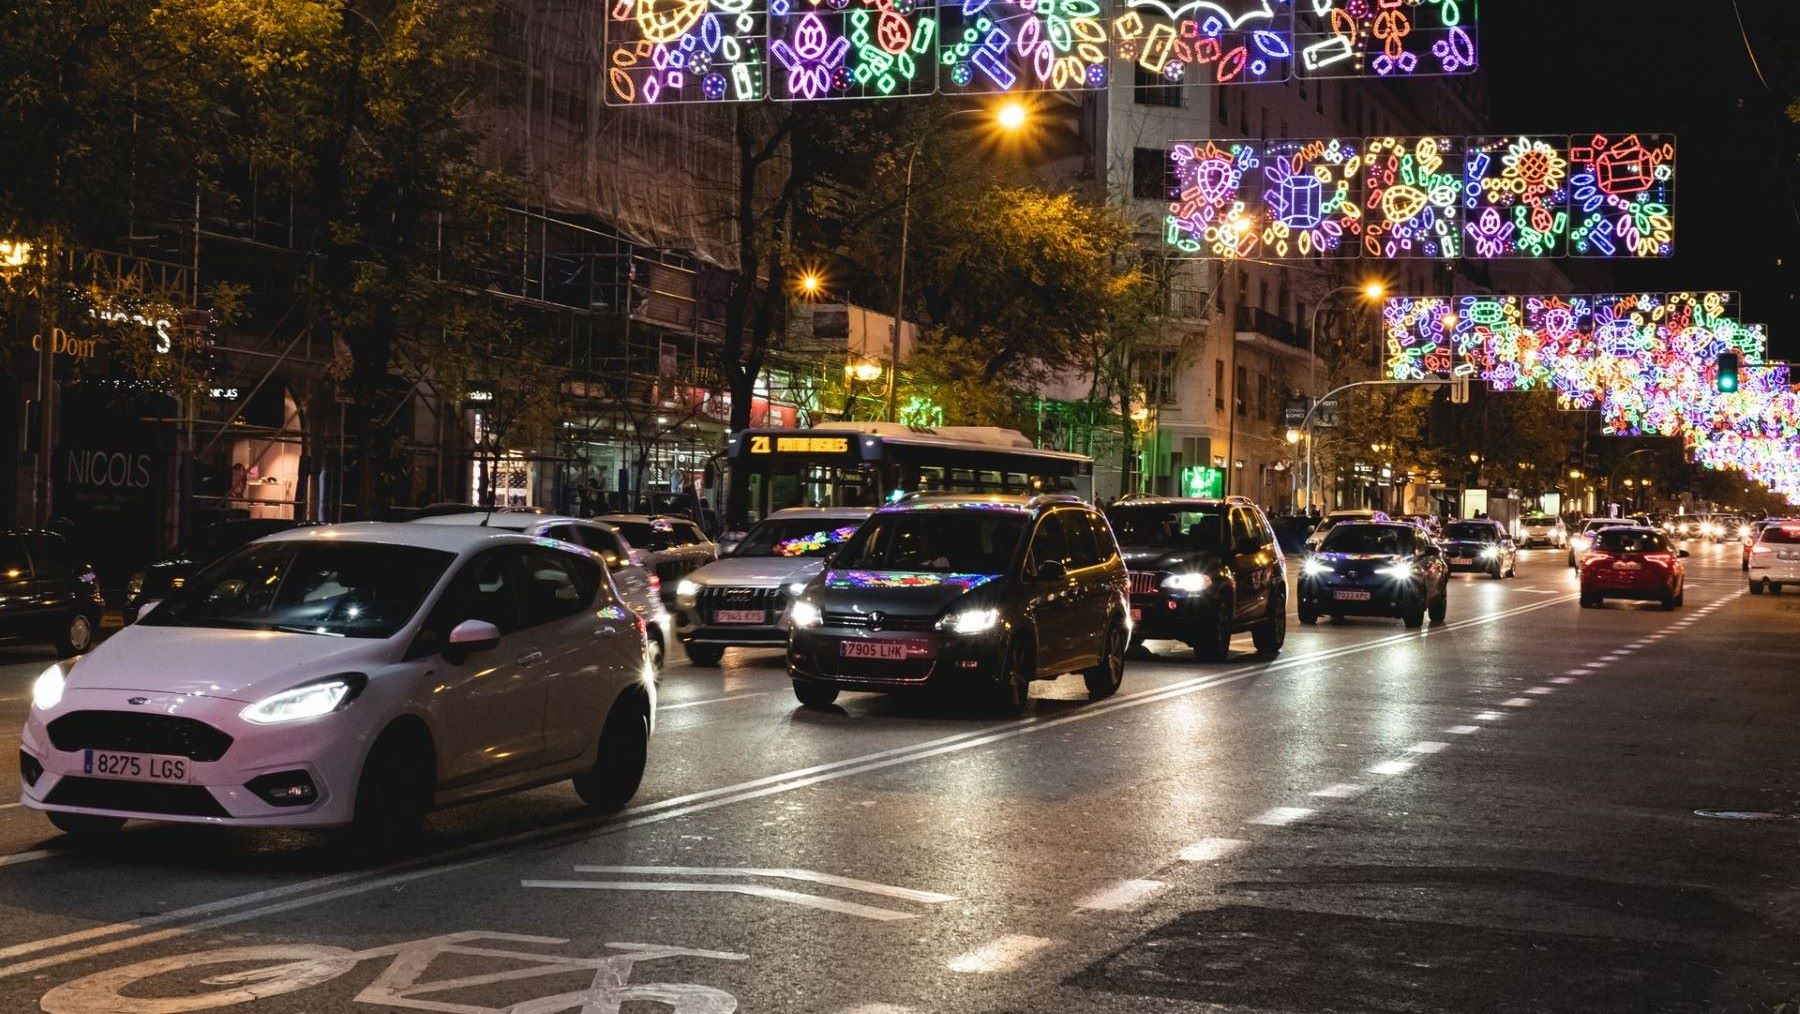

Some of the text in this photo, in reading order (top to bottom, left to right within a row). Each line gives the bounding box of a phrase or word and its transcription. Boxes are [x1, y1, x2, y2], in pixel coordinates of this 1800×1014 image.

[751, 436, 770, 453] 21
[67, 450, 151, 488] NICOLS
[848, 643, 877, 656] 7905
[98, 754, 185, 779] 8275 LGS
